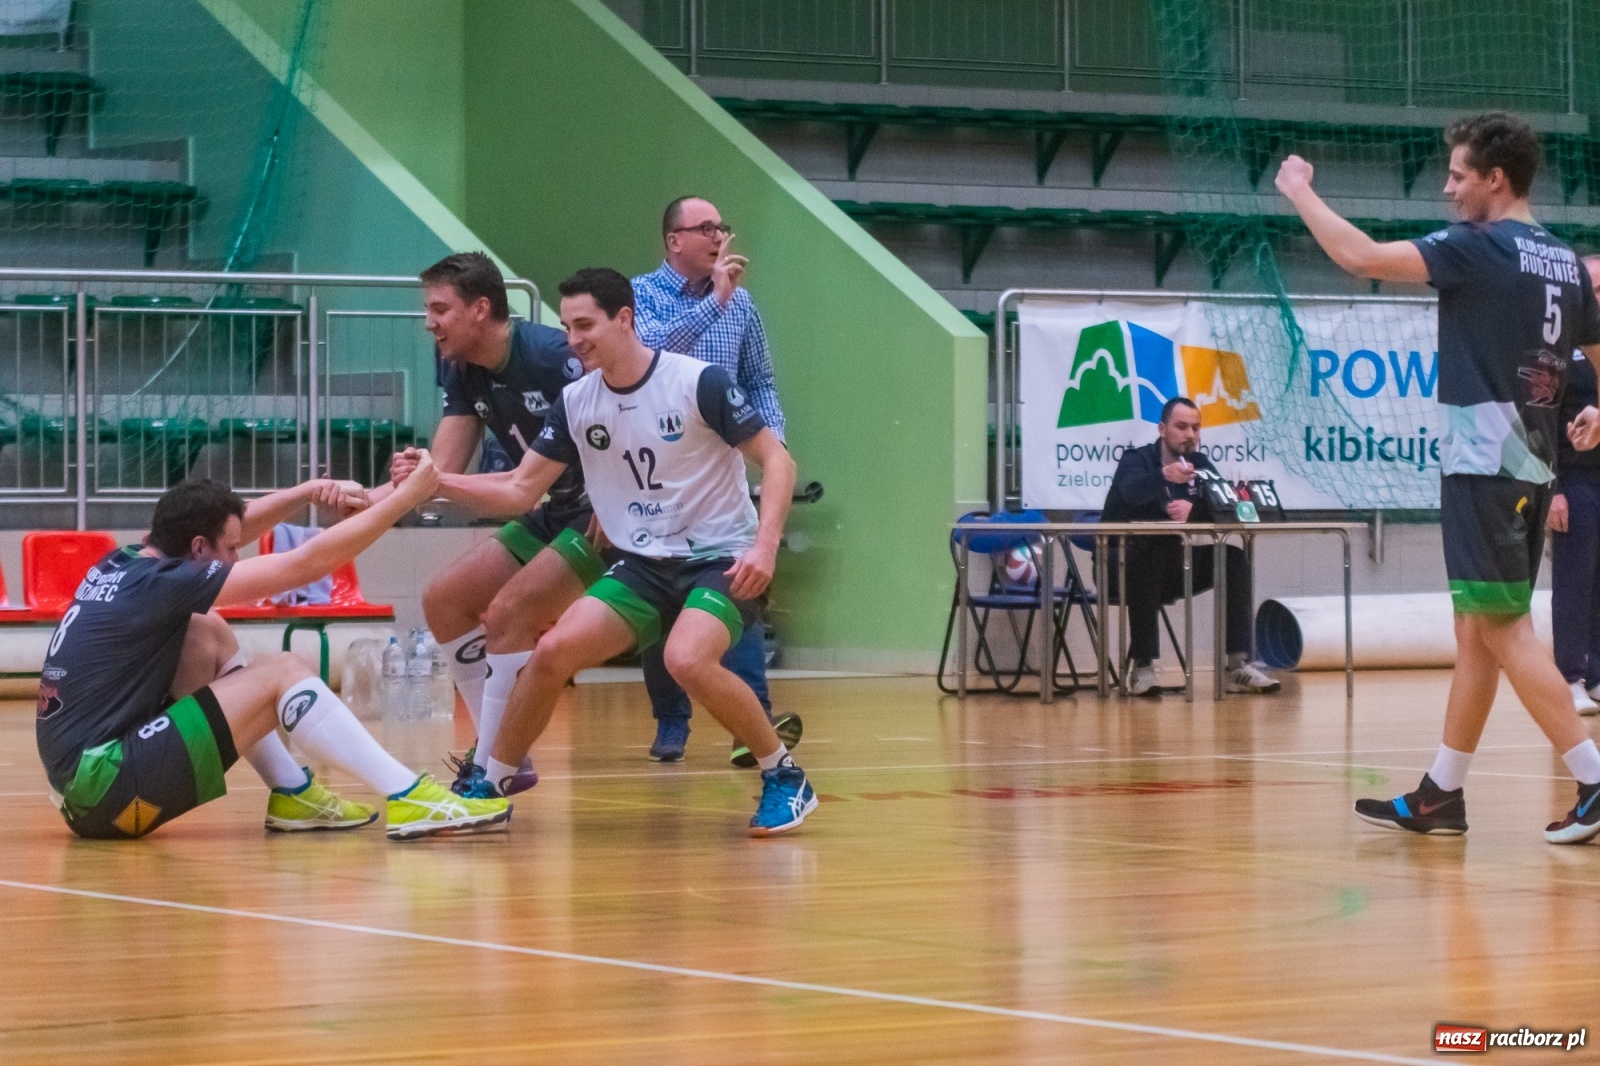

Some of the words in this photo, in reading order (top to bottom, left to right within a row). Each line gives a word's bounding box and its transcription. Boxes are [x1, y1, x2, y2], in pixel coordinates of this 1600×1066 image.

[1542, 283, 1562, 346] 5
[622, 446, 663, 490] 12
[1211, 483, 1239, 504] 14
[1252, 483, 1278, 507] 15
[50, 604, 80, 657] 8
[138, 716, 170, 739] 8
